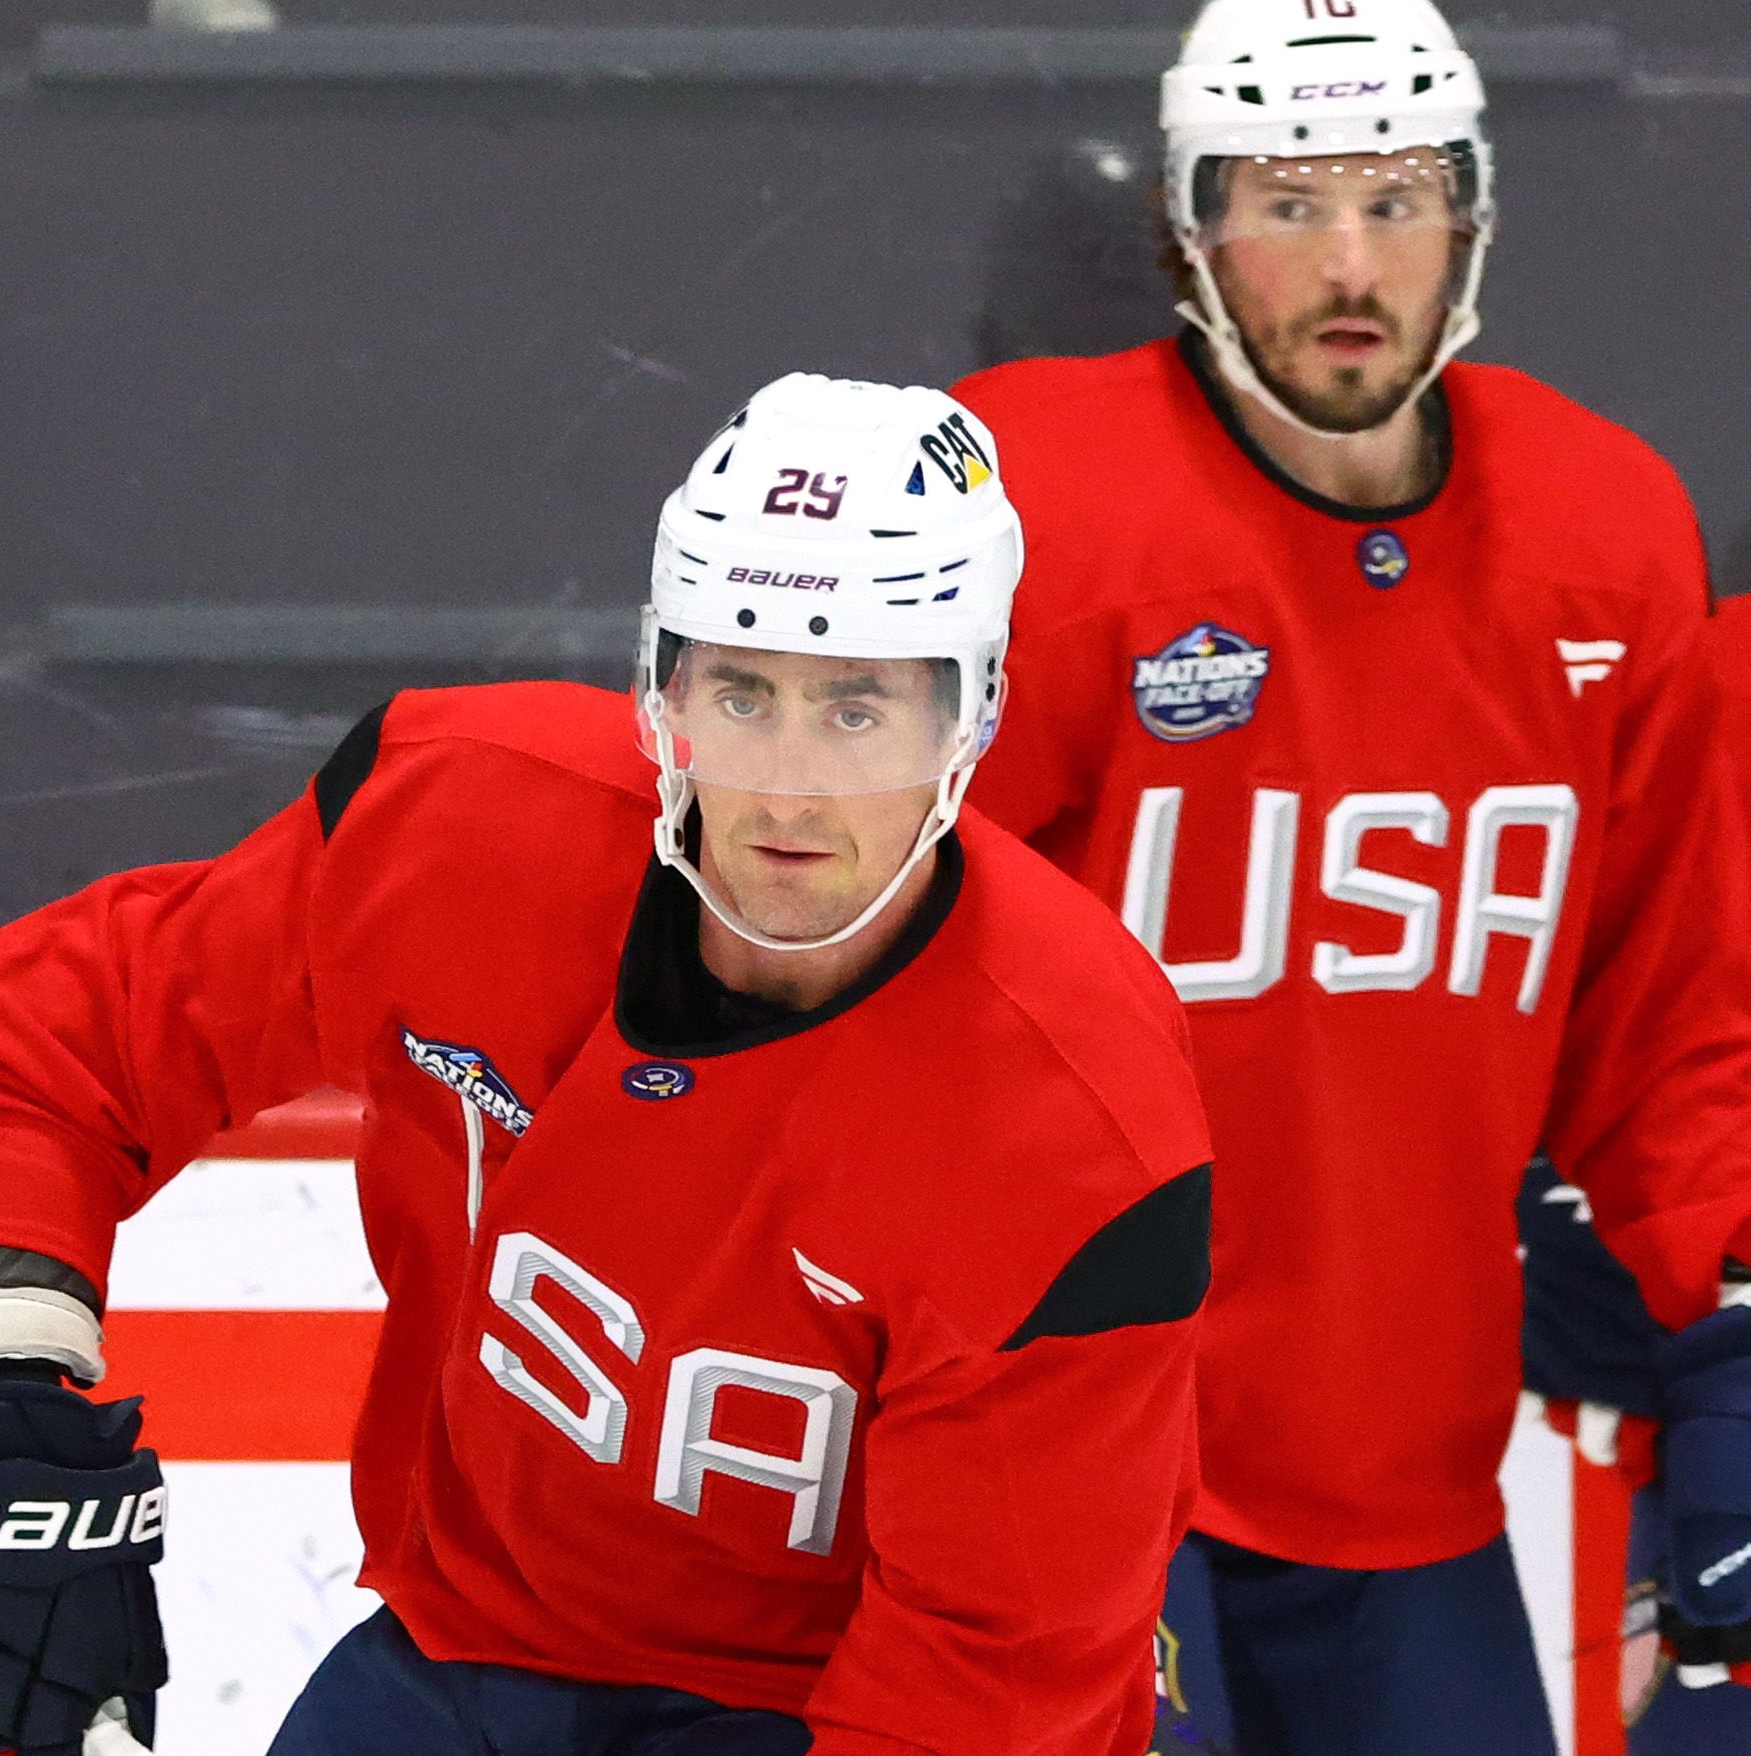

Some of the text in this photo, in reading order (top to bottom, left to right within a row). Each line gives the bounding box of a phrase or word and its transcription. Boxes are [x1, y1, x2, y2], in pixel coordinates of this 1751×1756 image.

[762, 468, 848, 520] 29
[920, 412, 992, 494] CAT
[1134, 650, 1268, 688] NATIONS
[1121, 784, 1578, 1014] USA
[404, 1032, 534, 1127] NATIONS
[460, 1092, 858, 1558] SA
